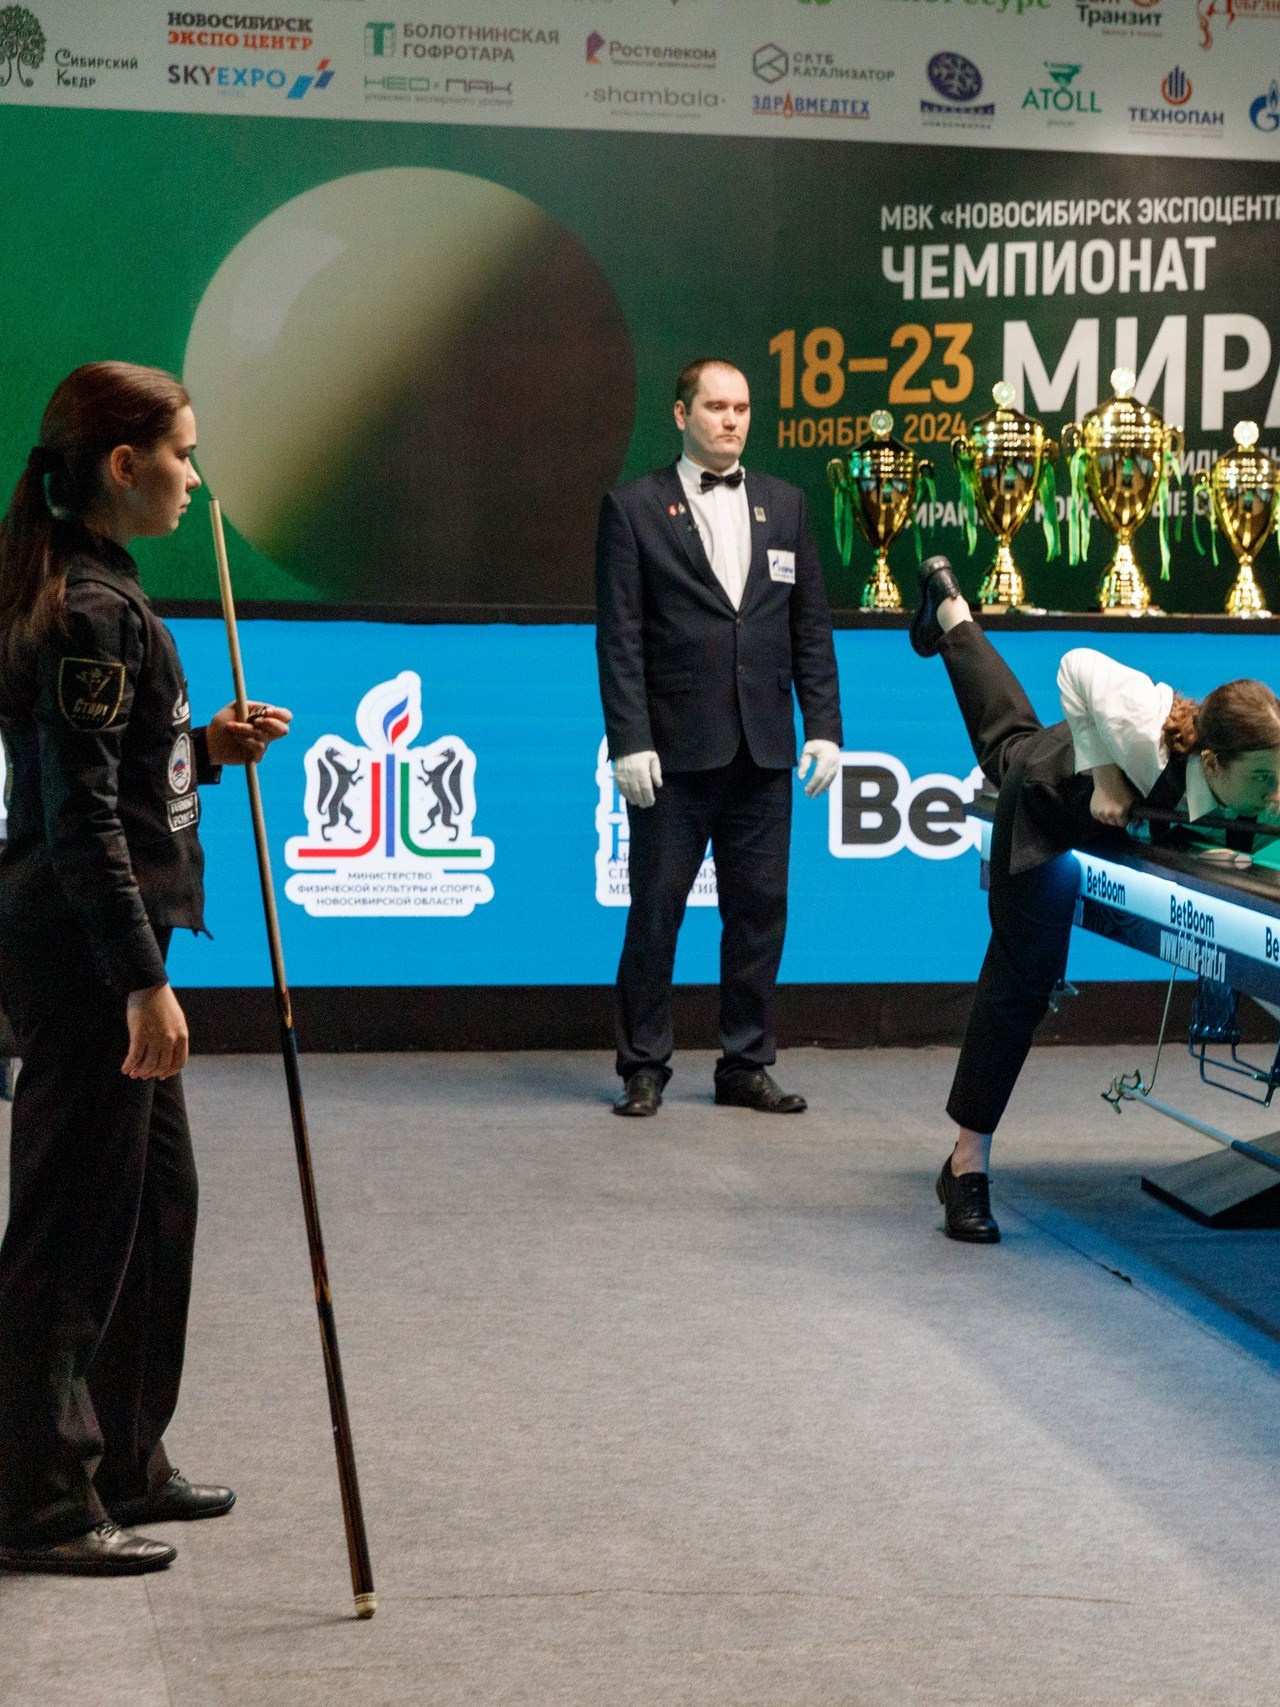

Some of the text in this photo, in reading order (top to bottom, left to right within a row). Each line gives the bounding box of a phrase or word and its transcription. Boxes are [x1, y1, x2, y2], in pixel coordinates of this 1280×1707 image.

[167, 11, 313, 33] НОВОСИБИРСК
[1076, 4, 1162, 27] Транзит
[403, 23, 560, 45] БОЛОТНИНСКАЯ
[403, 43, 516, 63] ГОФРОТАРА
[609, 40, 717, 60] Ростелеком
[168, 64, 287, 89] SKYEXPO
[793, 64, 896, 82] КАТАЛИЗАТОР
[752, 89, 870, 117] ЗДРАВМЕДТЕХ
[1021, 86, 1103, 114] ATOLL
[1128, 106, 1226, 127] ТЕХНОПАН
[880, 204, 934, 231] МВК
[940, 198, 1132, 230] «НОВОСИБИРСК
[882, 235, 1217, 300] ЧЕМПИОНАТ
[777, 413, 968, 449] НОЯБР 2024
[347, 871, 433, 881] МИНИСТЕРСТВО
[1087, 866, 1125, 906] BetBoom
[297, 884, 482, 894] ФИЗИЧЕСКОЙ КУЛЬТУРЫ И СПОРТА
[316, 897, 463, 907] НОВОСИБИРСКОЙ ОБЛАСТИ
[1170, 895, 1215, 938] BetBoom
